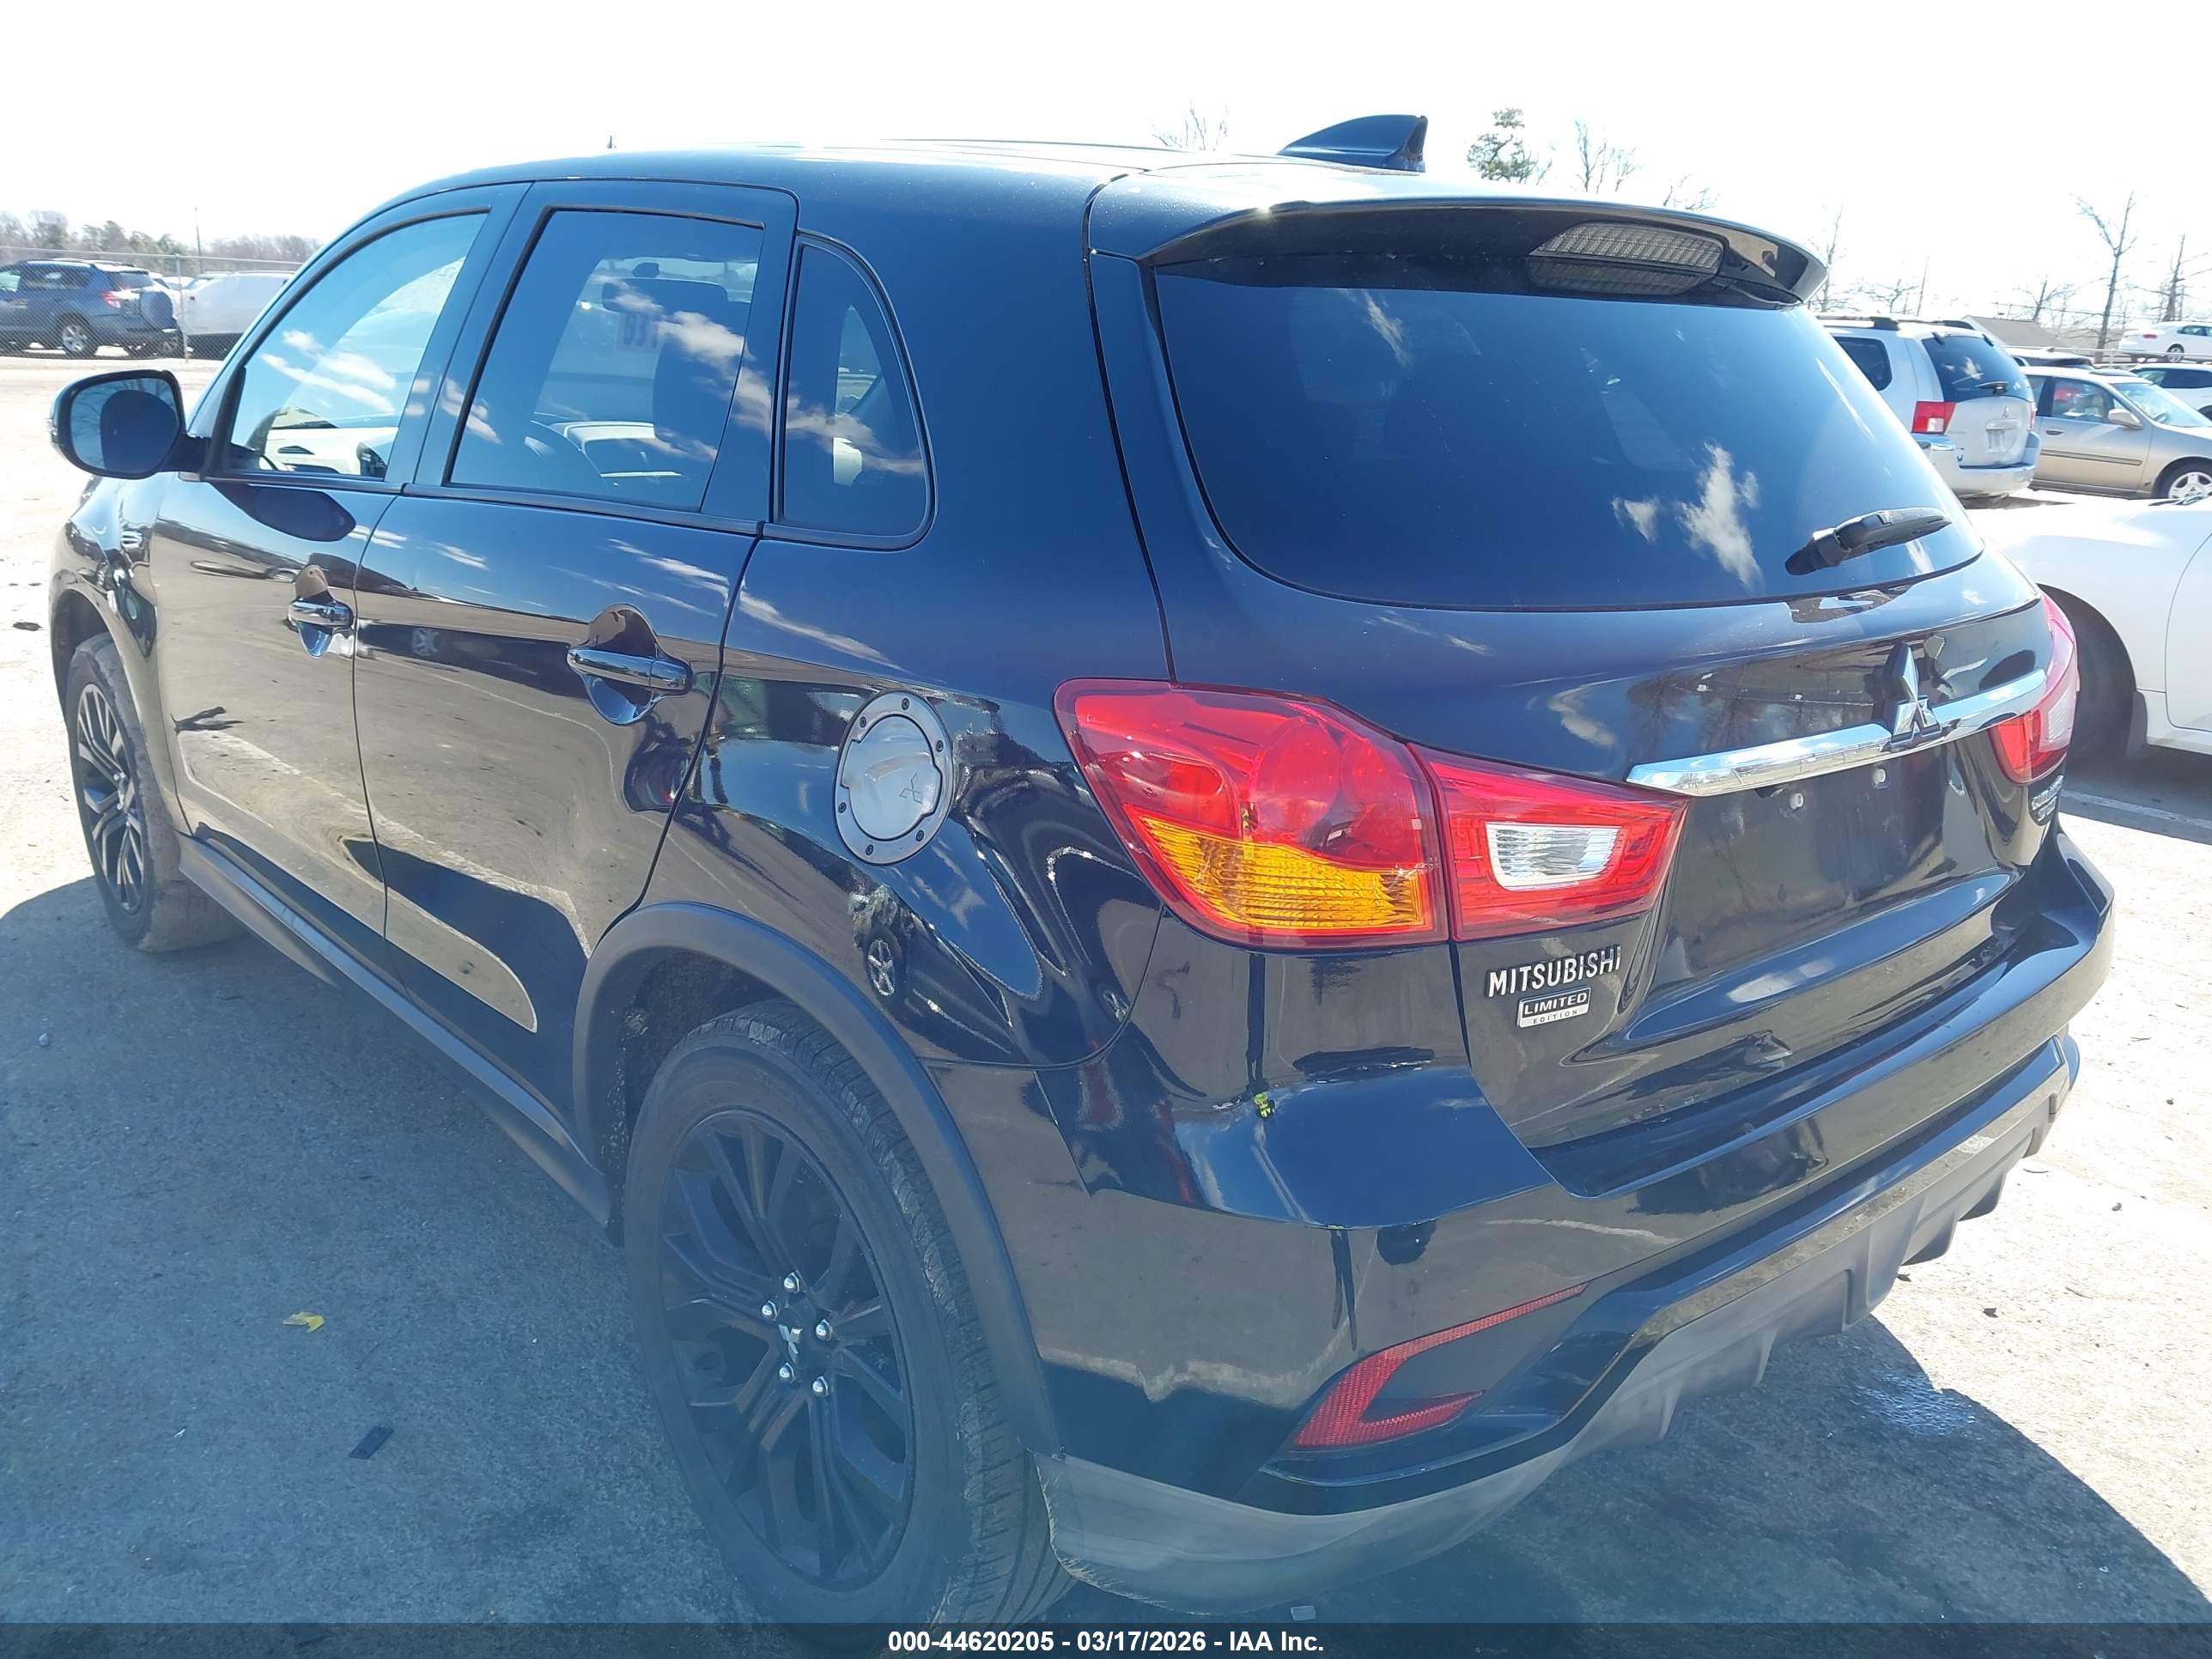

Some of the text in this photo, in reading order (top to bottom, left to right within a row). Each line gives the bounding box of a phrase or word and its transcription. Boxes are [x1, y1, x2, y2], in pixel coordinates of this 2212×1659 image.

[1487, 945, 1621, 998] MITSUBISHI
[1525, 993, 1587, 1015] LIMITED
[1533, 1009, 1578, 1024] EDITION
